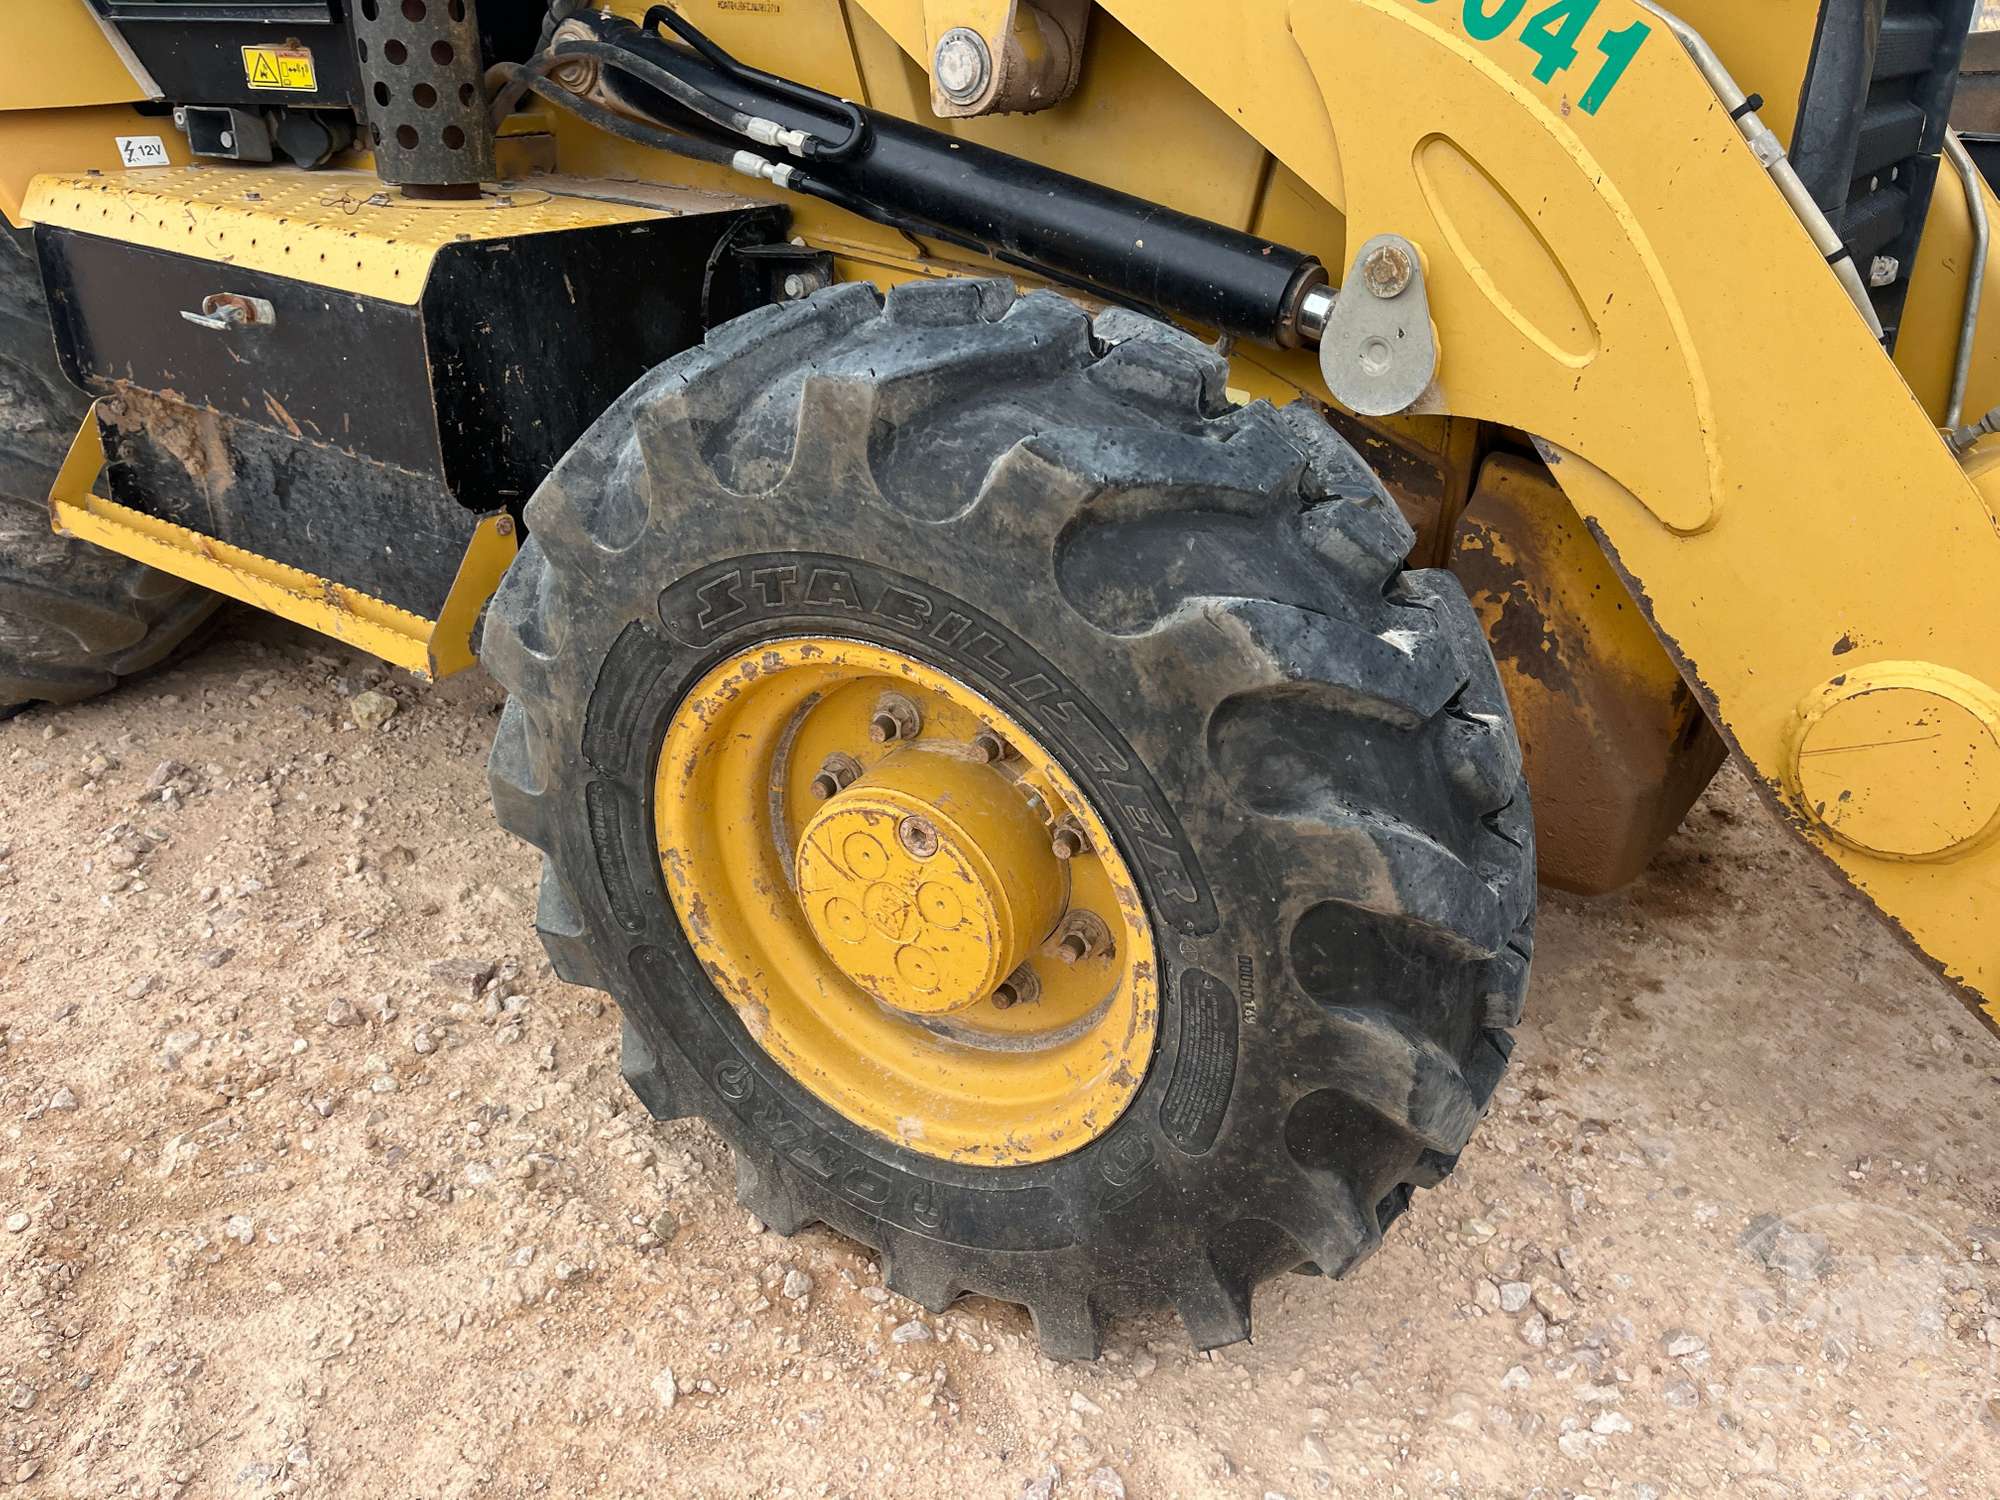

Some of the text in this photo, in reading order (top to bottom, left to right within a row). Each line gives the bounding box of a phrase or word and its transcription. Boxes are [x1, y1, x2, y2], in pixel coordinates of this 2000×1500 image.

[1415, 0, 1652, 117] 41
[138, 144, 161, 156] 12V
[697, 565, 1198, 903] STABILIZER
